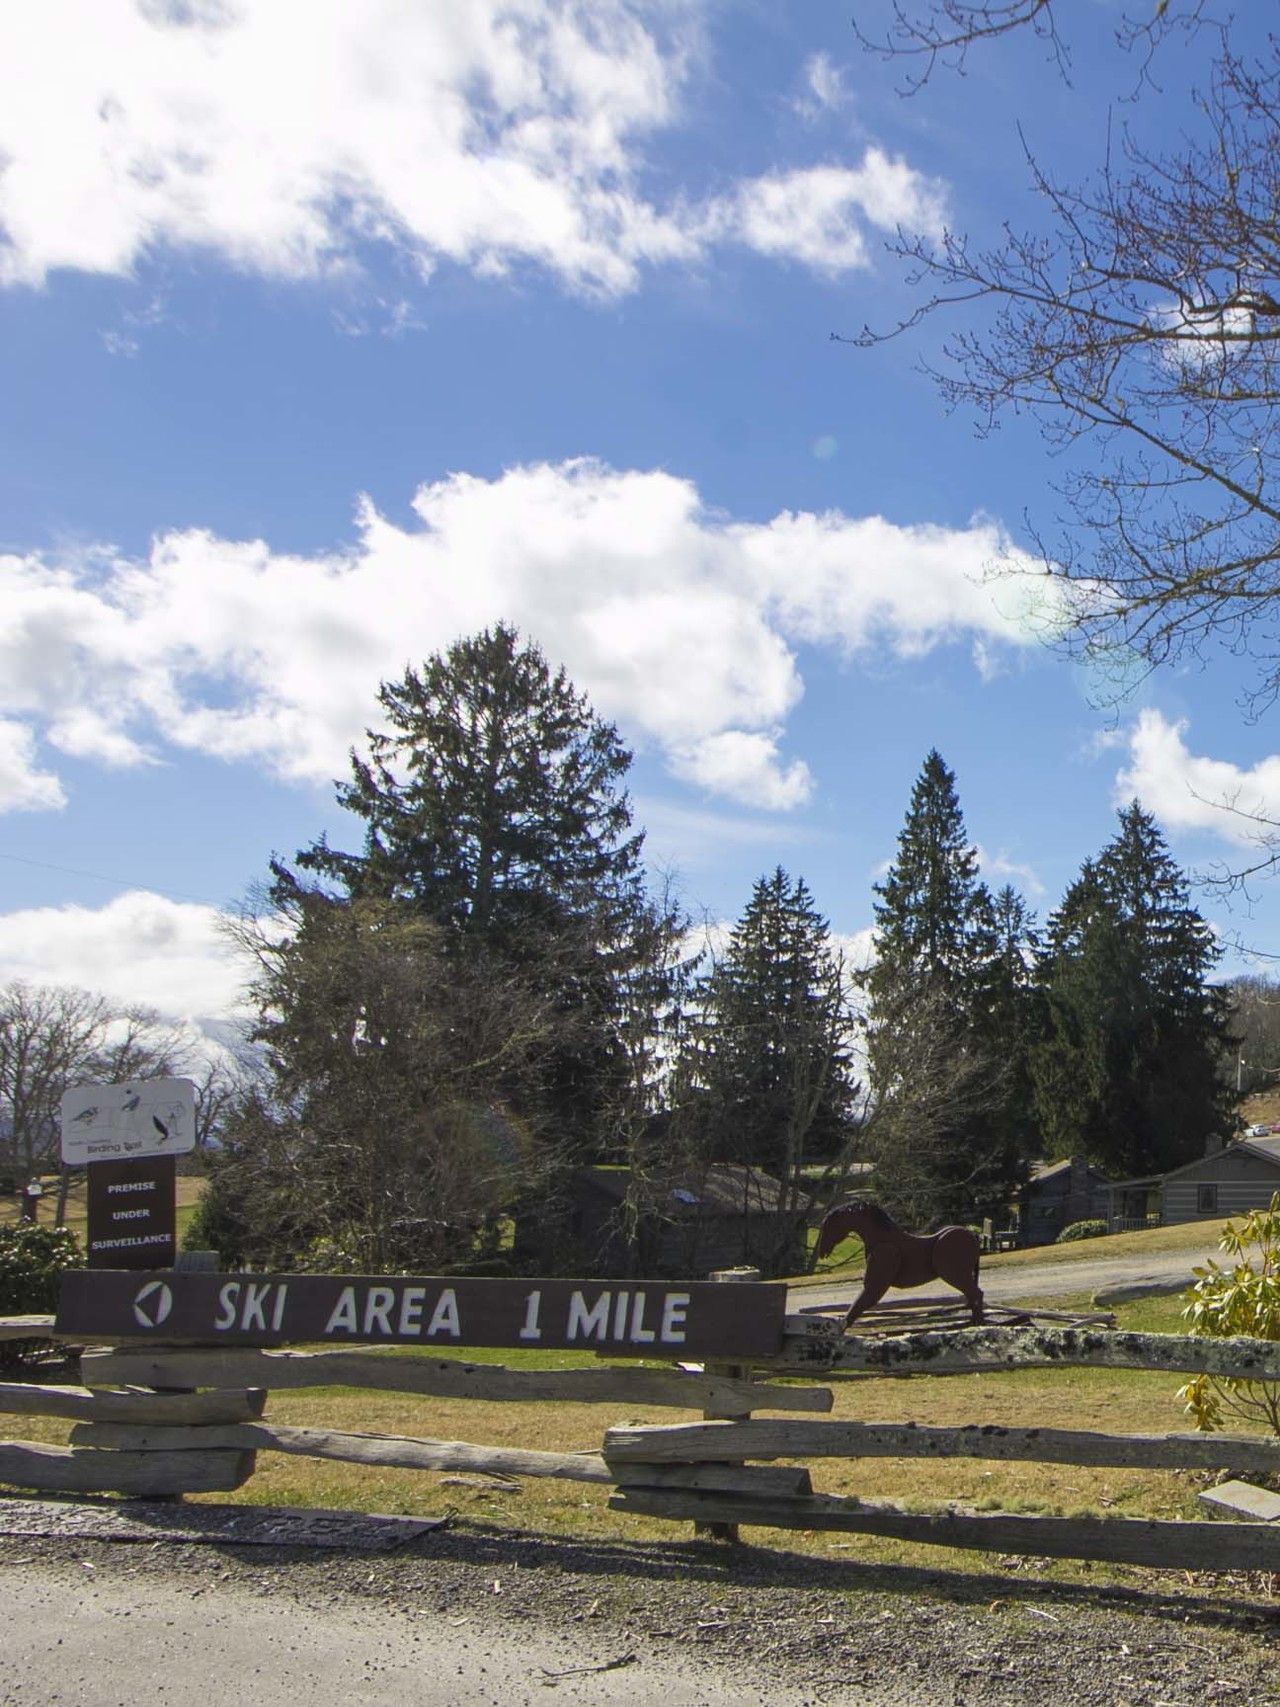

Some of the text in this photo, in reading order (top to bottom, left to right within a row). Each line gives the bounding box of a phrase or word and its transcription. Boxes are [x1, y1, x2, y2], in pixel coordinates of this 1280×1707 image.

[107, 1181, 156, 1194] PREMISE
[112, 1208, 150, 1220] UNDER
[91, 1233, 172, 1250] SURVEILLANCE
[214, 1282, 690, 1343] SKI AREA 1 MILE
